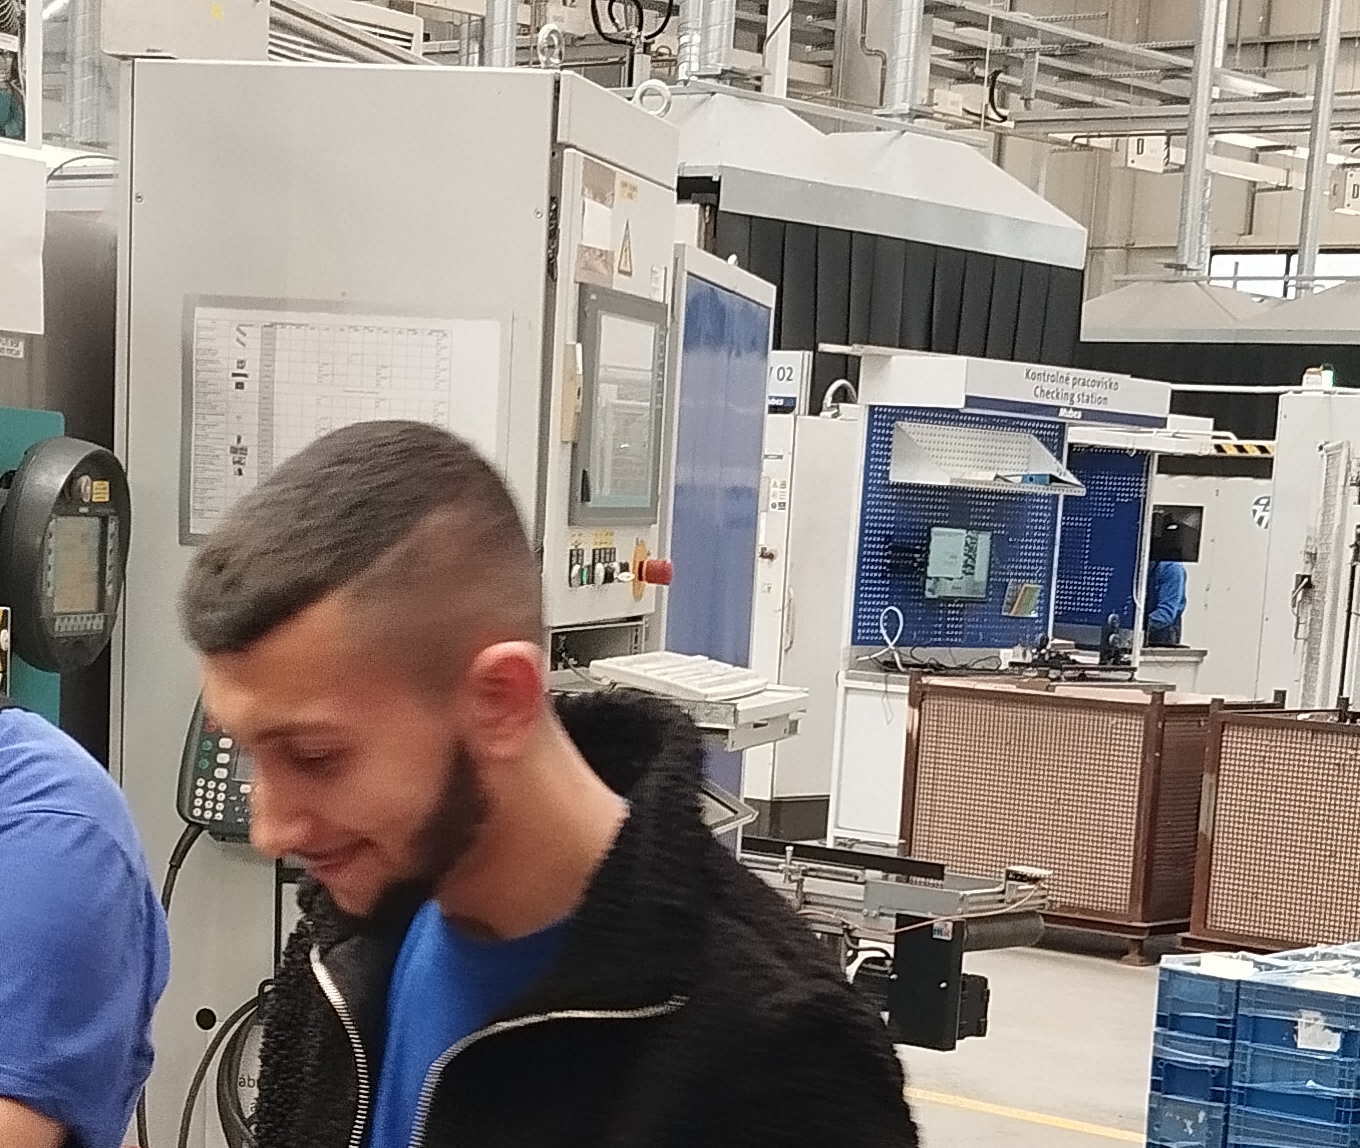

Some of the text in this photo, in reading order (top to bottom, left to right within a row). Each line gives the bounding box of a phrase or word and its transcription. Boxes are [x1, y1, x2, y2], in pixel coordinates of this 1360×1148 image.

[776, 366, 794, 382] 02
[1025, 368, 1119, 391] Kontrolné pracovisko
[1034, 386, 1108, 405] Checking station
